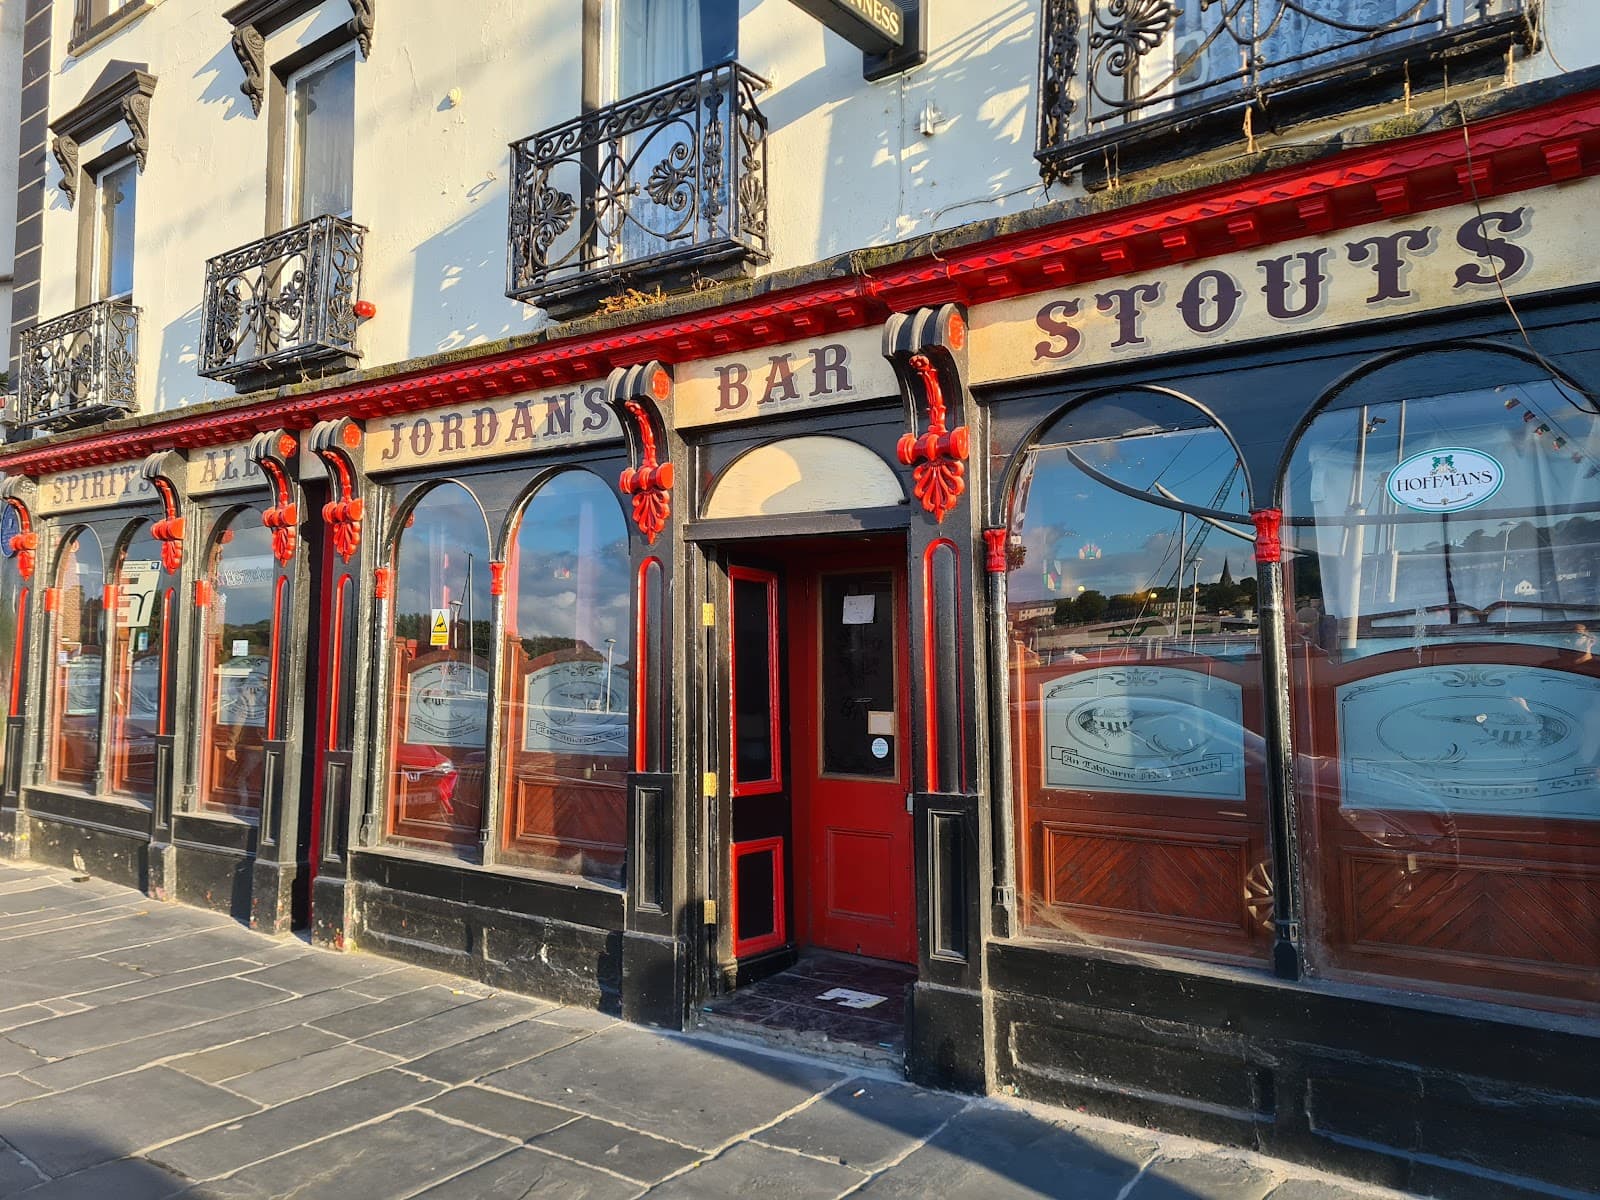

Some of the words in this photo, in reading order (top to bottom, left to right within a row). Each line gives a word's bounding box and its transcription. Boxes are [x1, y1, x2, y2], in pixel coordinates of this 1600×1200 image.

[1033, 206, 1526, 360] STOUTS
[382, 384, 609, 461] JORDAN'S
[714, 343, 853, 412] BAR
[1397, 470, 1493, 492] HOFFMANS
